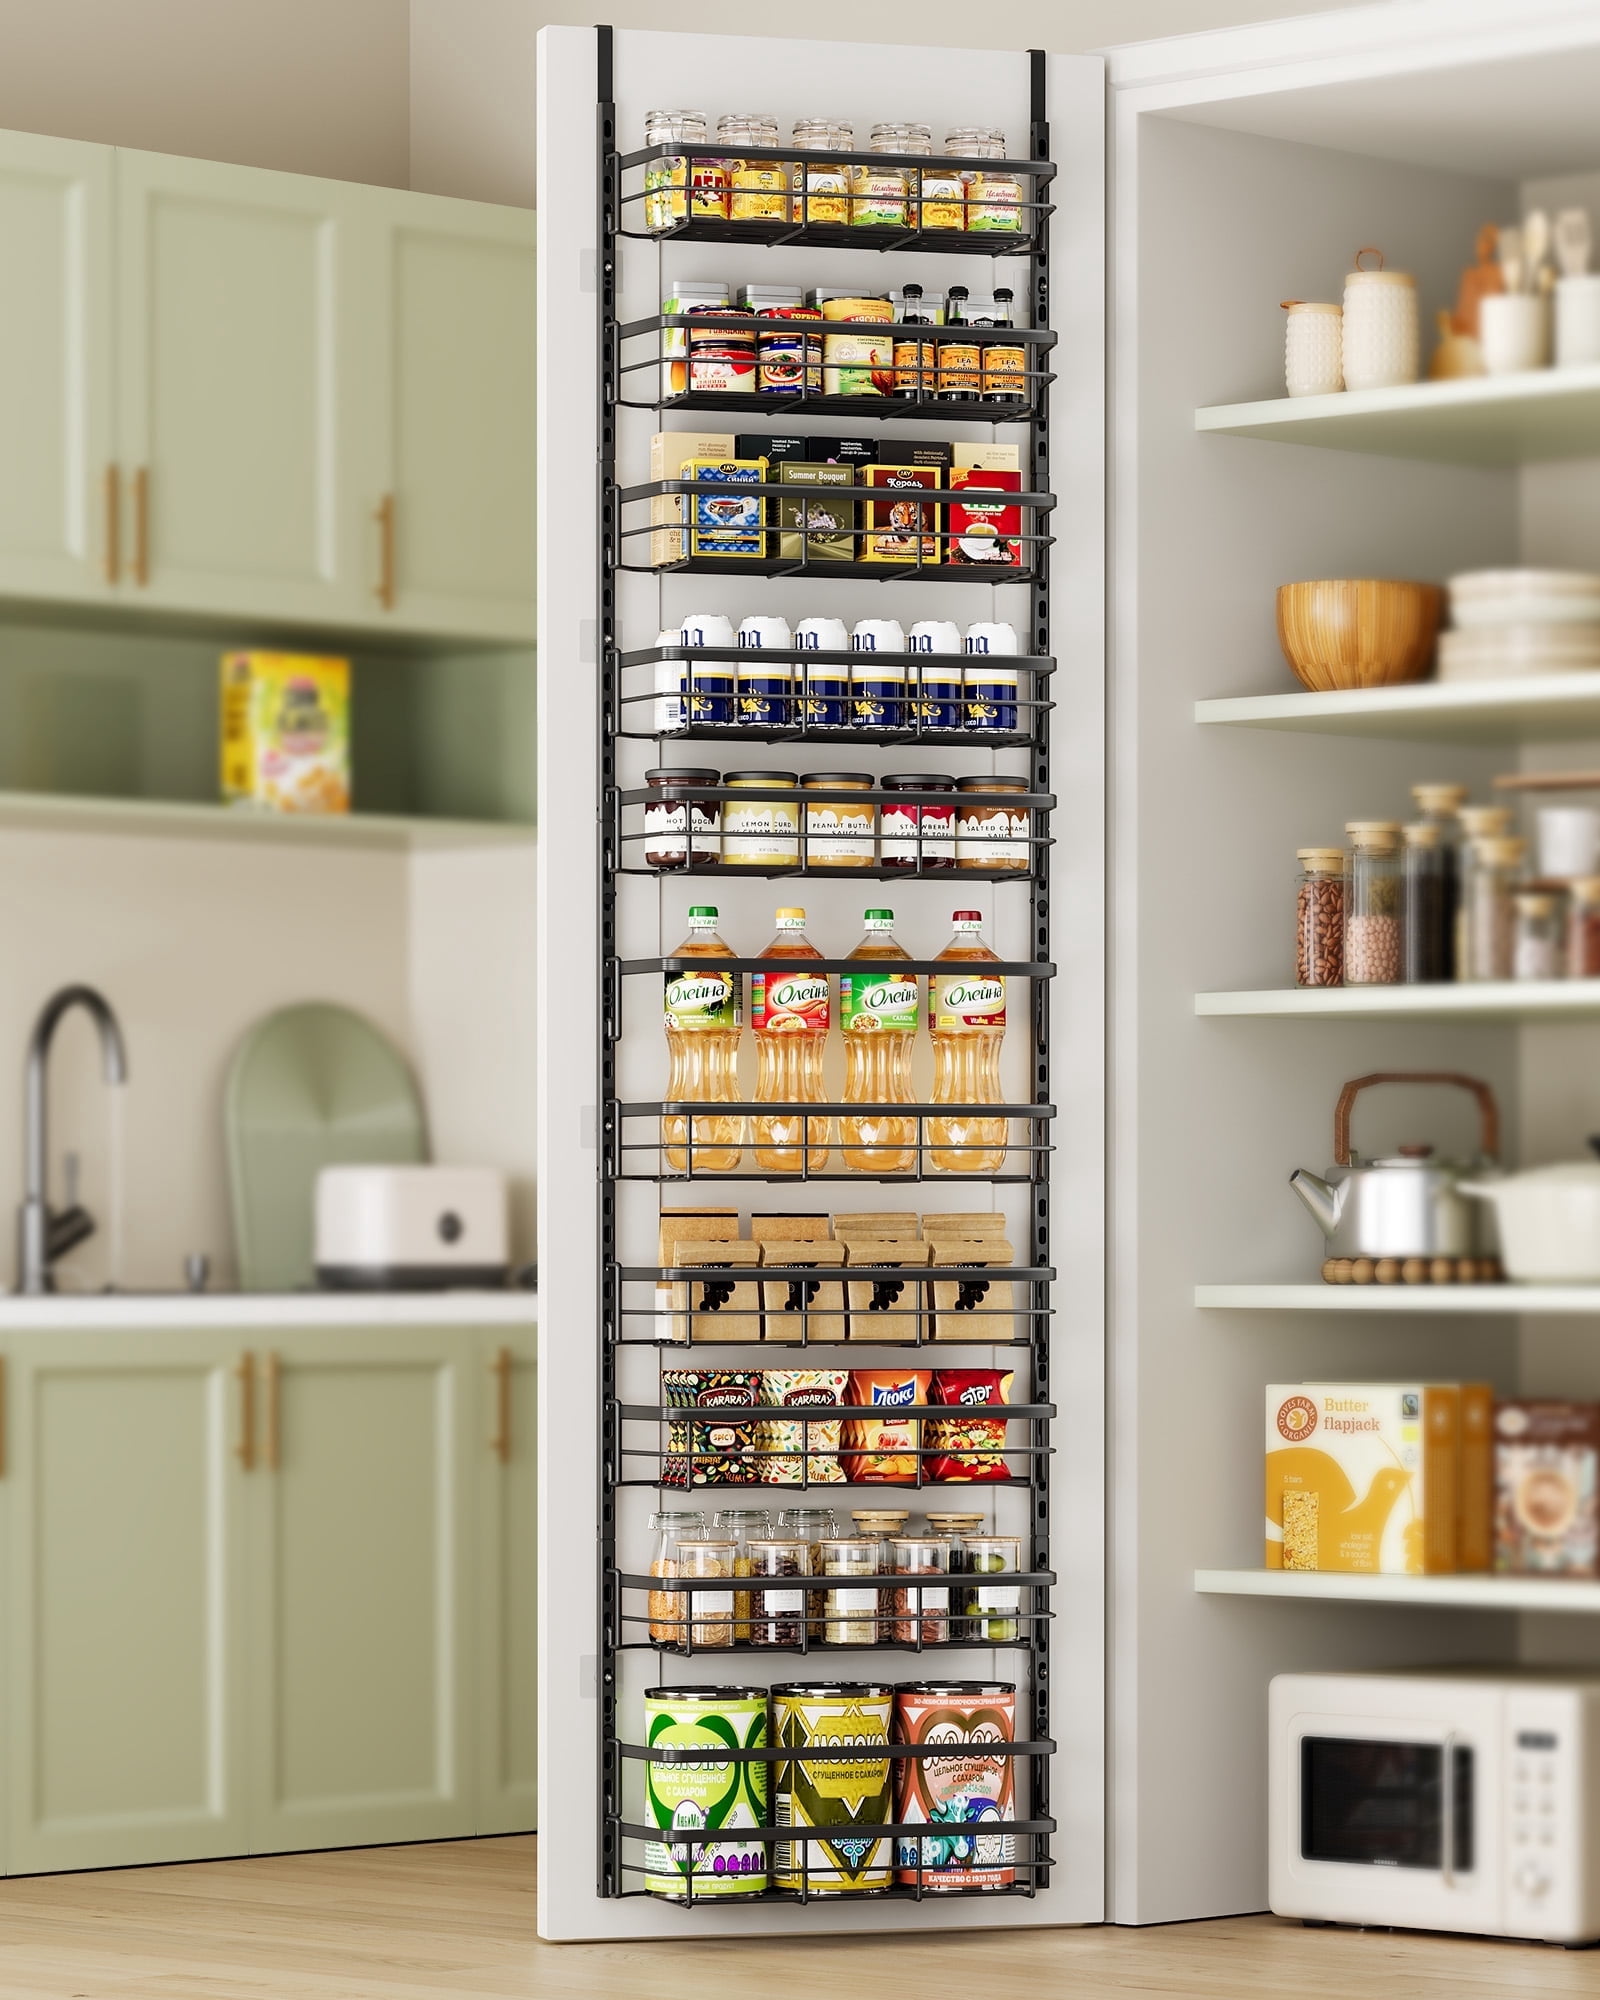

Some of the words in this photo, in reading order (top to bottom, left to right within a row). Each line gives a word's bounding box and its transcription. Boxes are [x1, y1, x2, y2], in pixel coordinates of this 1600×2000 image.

[788, 470, 816, 480] Summer
[818, 471, 847, 483] Bouquet
[886, 478, 923, 489] Король
[670, 985, 725, 1005] Олейна
[950, 986, 1002, 1006] Олейна
[706, 1394, 748, 1407] KARARAY
[791, 1394, 833, 1407] KARARAY
[876, 1386, 914, 1405] Люкс
[960, 1385, 993, 1406] Star
[1324, 1398, 1369, 1411] Butter
[1283, 1420, 1316, 1440] ORGANIC
[1324, 1416, 1380, 1434] flapjack
[713, 1433, 734, 1441] SPICY
[812, 1733, 885, 1764] МОЛОКО
[812, 1771, 854, 1780] СГУЩЕННОЕ
[860, 1770, 884, 1778] САХАРОМ
[933, 1763, 963, 1777] ЦЕЛЬНОЕ
[964, 1763, 999, 1776] СГУЩЕННОЕ
[654, 1773, 680, 1784] ЦЕЛЬНОЕ
[681, 1774, 727, 1785] СГУЩЕННОЕ
[957, 1773, 985, 1782] САХАРОМ
[673, 1787, 707, 1797] САХАРОМ
[972, 1874, 987, 1882] 1939
[987, 1874, 1002, 1882] ГОДА
